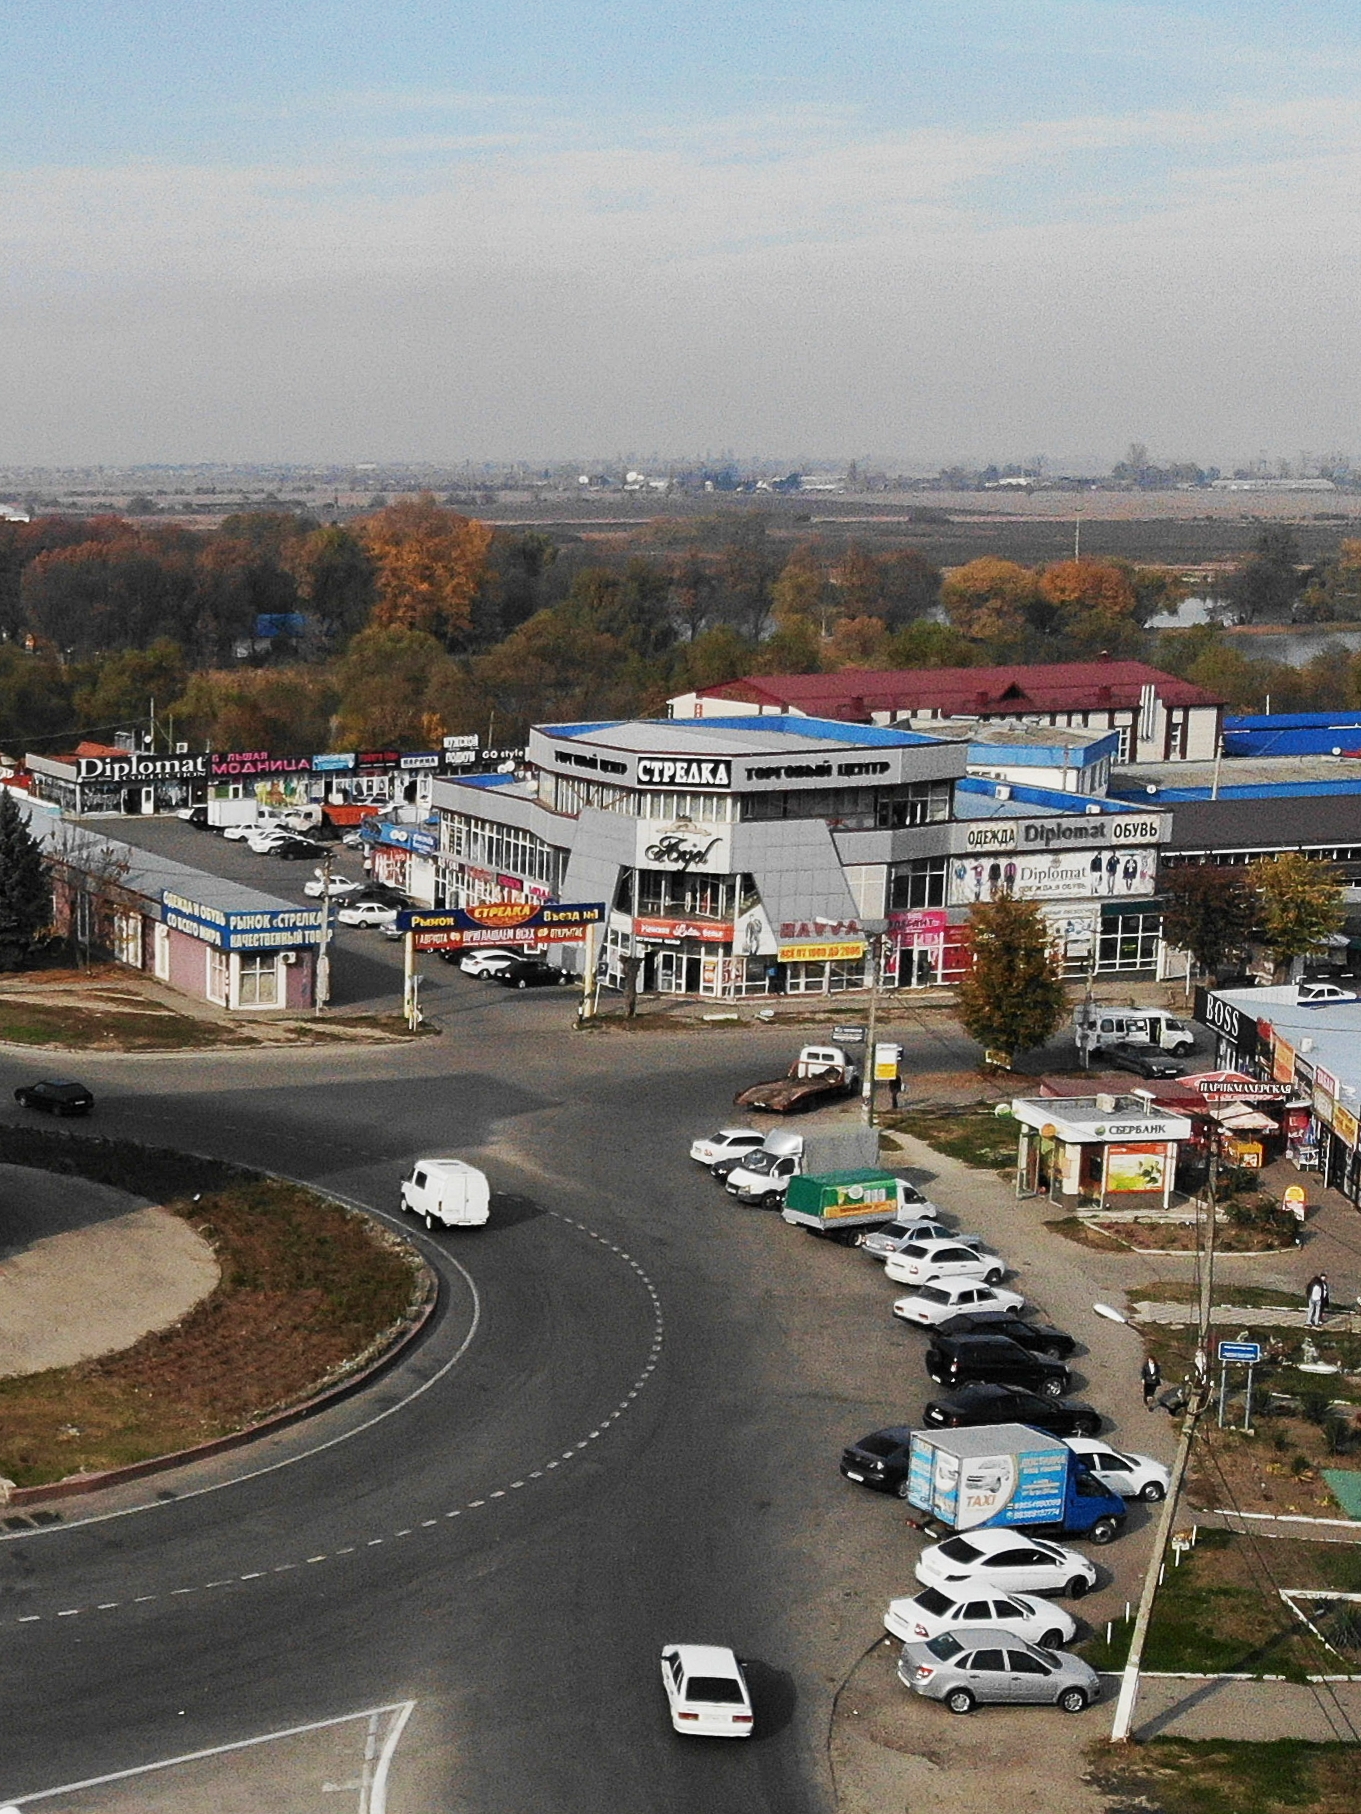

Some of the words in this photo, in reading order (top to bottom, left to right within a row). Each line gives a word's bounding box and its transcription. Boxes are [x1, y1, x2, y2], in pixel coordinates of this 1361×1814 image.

[212, 752, 268, 762] БЛЬШАЯ
[77, 755, 206, 782] Diplomat
[212, 759, 310, 774] МОДНИЦА
[638, 760, 729, 784] СТРЕЛКА
[745, 760, 832, 781] ТОРГОВЫЙ
[837, 761, 891, 777] ЦЕНТР
[968, 828, 1016, 847] ОДЕЖДА
[1024, 822, 1107, 846] Diplomat
[1113, 822, 1158, 838] ОБУВЬ
[1021, 862, 1087, 883] Diplomat
[163, 891, 193, 915] ОДЕЖДА
[200, 905, 226, 926] ОБУВЬ
[474, 905, 530, 918] СТРЕЛКА
[543, 910, 580, 922] Въезд
[230, 914, 271, 931] РЫНОК
[412, 916, 454, 927] Рынок
[199, 925, 221, 946] МИРА
[230, 929, 303, 947] КАЧЕСТВЕННЫЙ
[515, 928, 535, 940] ВСЕХ
[1206, 993, 1239, 1036] BOSS
[1200, 1083, 1292, 1094] ПАРИКМАХЕРСКАЯ
[1109, 1124, 1167, 1135] СБЕРБАНК
[966, 1495, 997, 1507] TAXI
